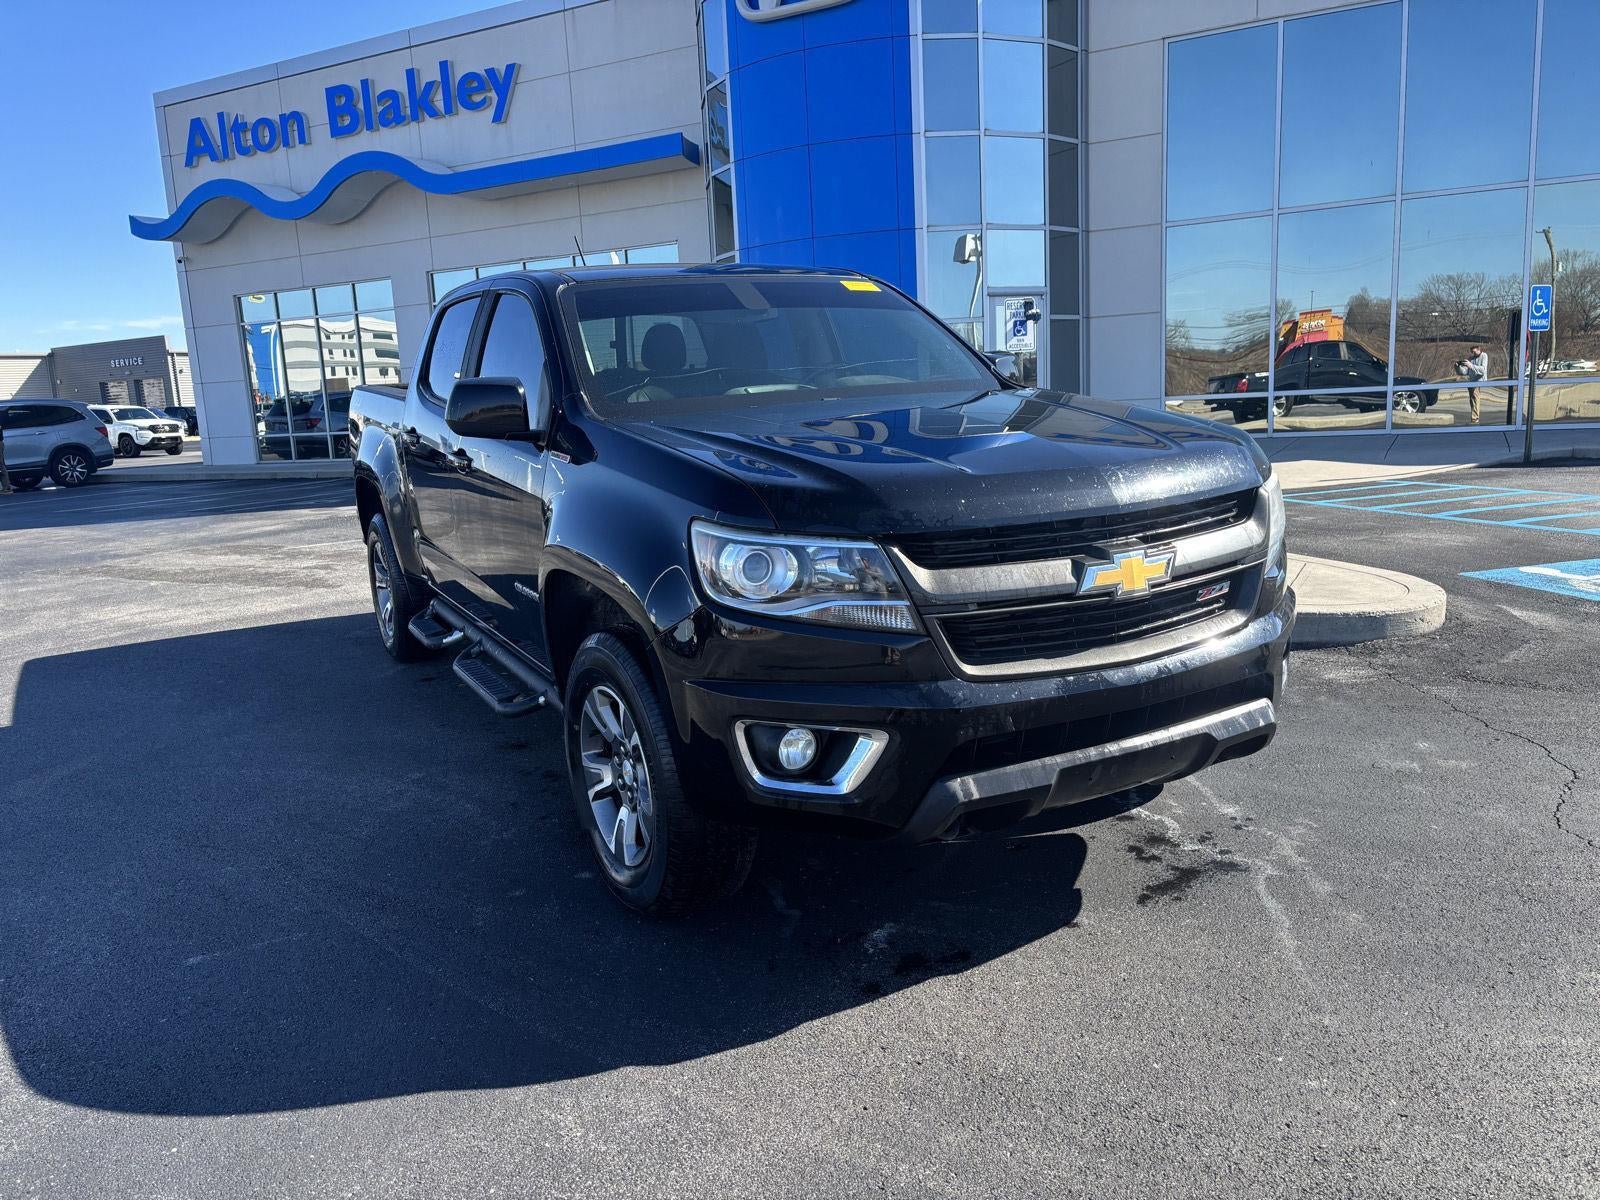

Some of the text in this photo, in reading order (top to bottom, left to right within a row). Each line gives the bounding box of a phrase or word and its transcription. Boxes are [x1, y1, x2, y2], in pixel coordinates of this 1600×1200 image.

[185, 60, 518, 167] Alton Blakley
[1530, 318, 1549, 327] PARKING
[110, 357, 144, 368] SERVICE
